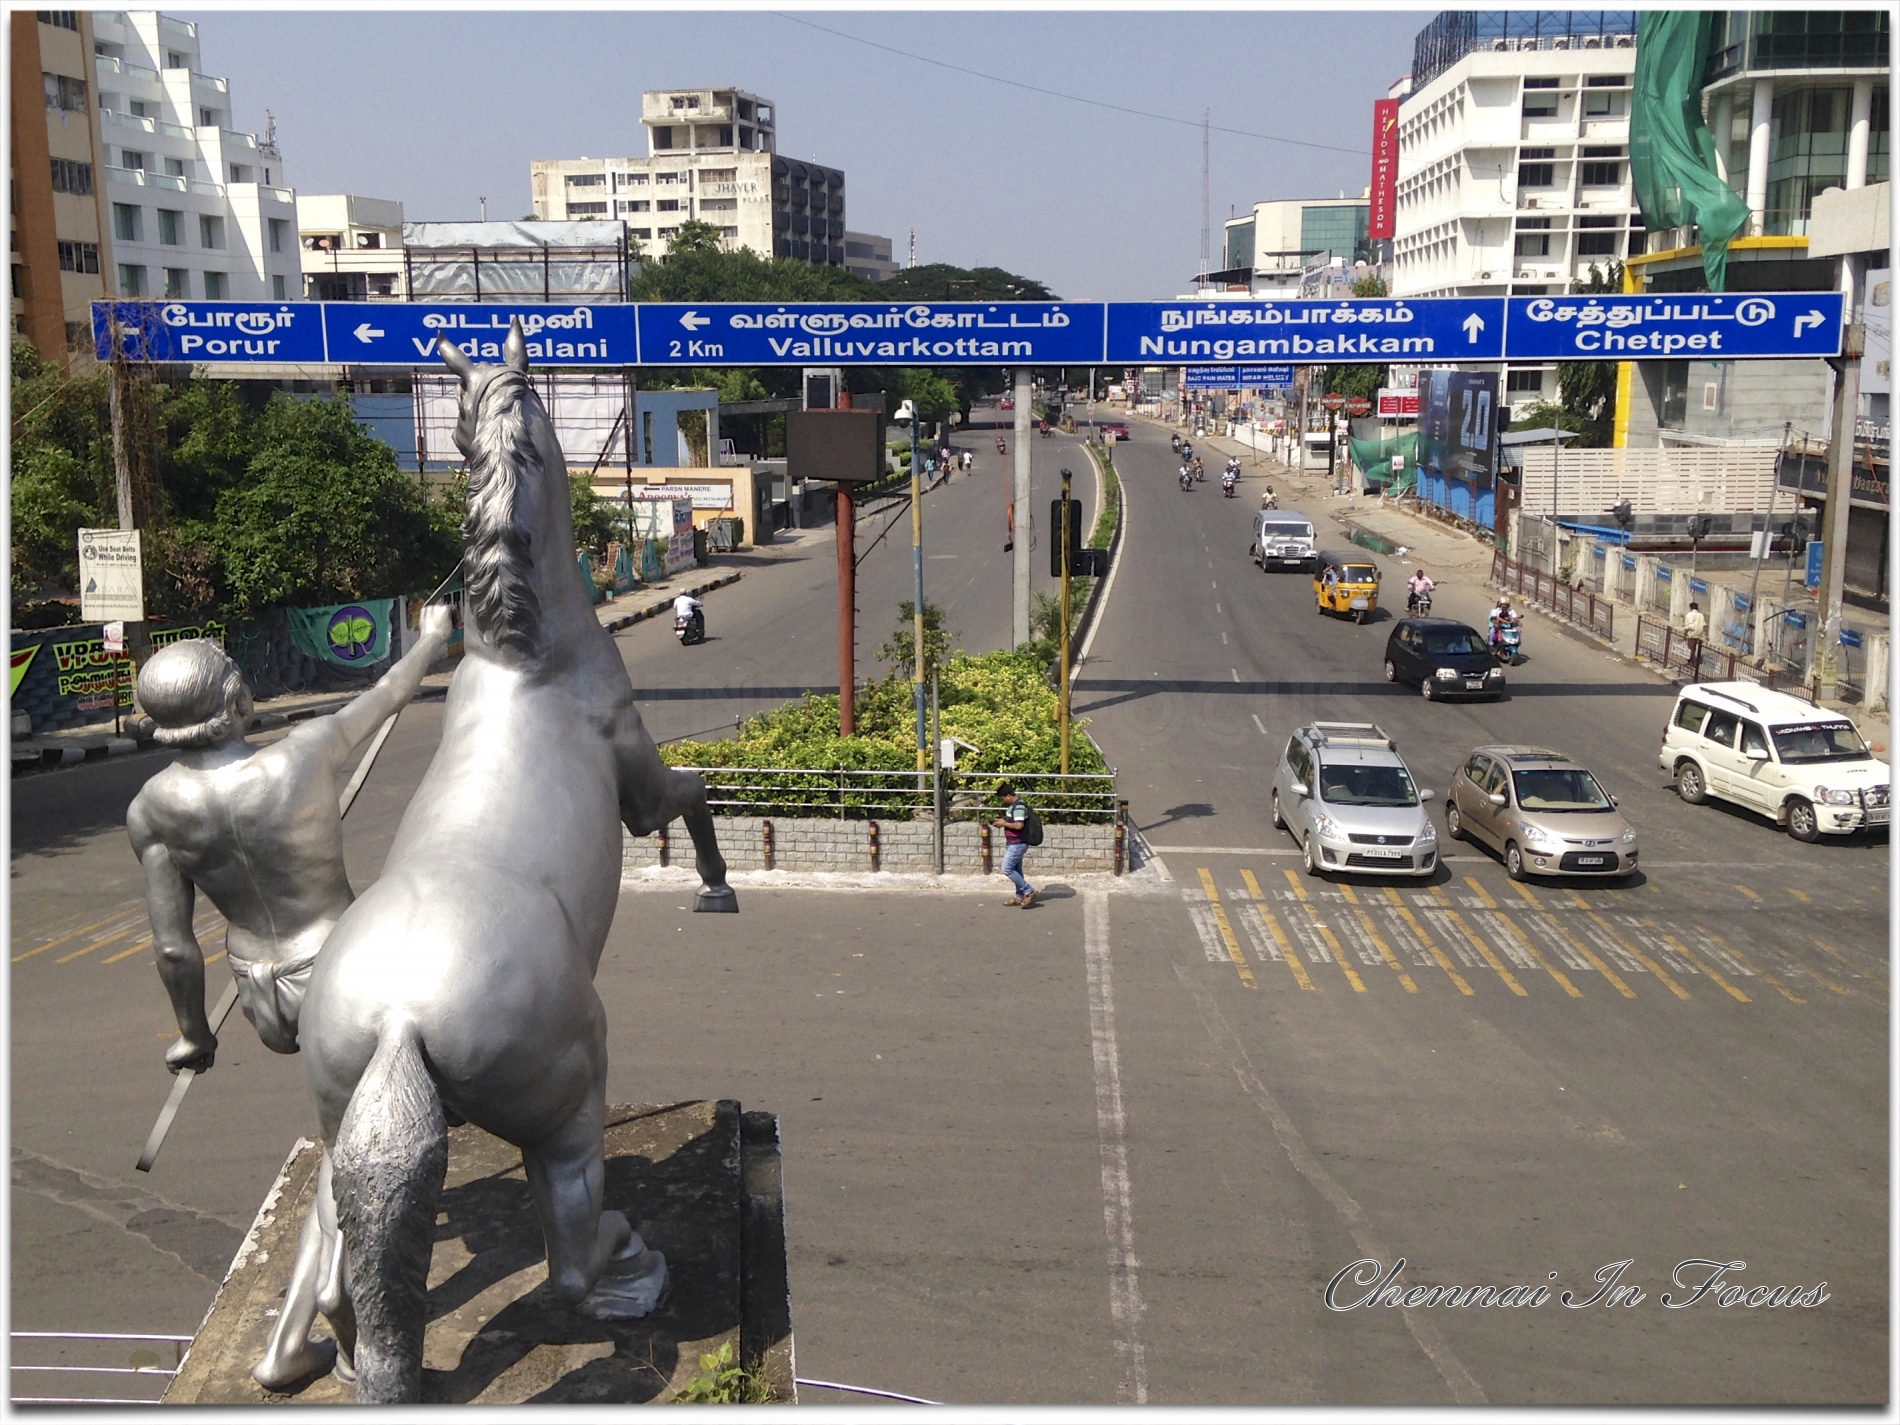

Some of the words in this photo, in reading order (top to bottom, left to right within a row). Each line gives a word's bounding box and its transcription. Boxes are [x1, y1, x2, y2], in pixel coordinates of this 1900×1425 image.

[1380, 108, 1389, 156] HELIOS
[716, 182, 758, 193] JHAVER
[1376, 166, 1387, 229] MATHESON
[161, 304, 296, 335] போரூர்
[422, 306, 593, 337] வடபழனி
[729, 305, 1071, 336] வள்ளுவர்கோட்டம்
[1160, 301, 1415, 332] நுங்கம்பாக்கம்
[1525, 297, 1776, 329] சேத்துப்பட்டு
[180, 335, 281, 355] Porur
[411, 338, 608, 358] Vdaalani
[669, 340, 682, 358] 2
[688, 340, 723, 358] Km
[767, 337, 1033, 358] Valluvarkottam
[1140, 334, 1435, 360] Nungambakkam
[1575, 330, 1723, 354] Chetpet
[1460, 389, 1491, 451] 2.0
[98, 553, 115, 561] While
[116, 553, 137, 563] Driving
